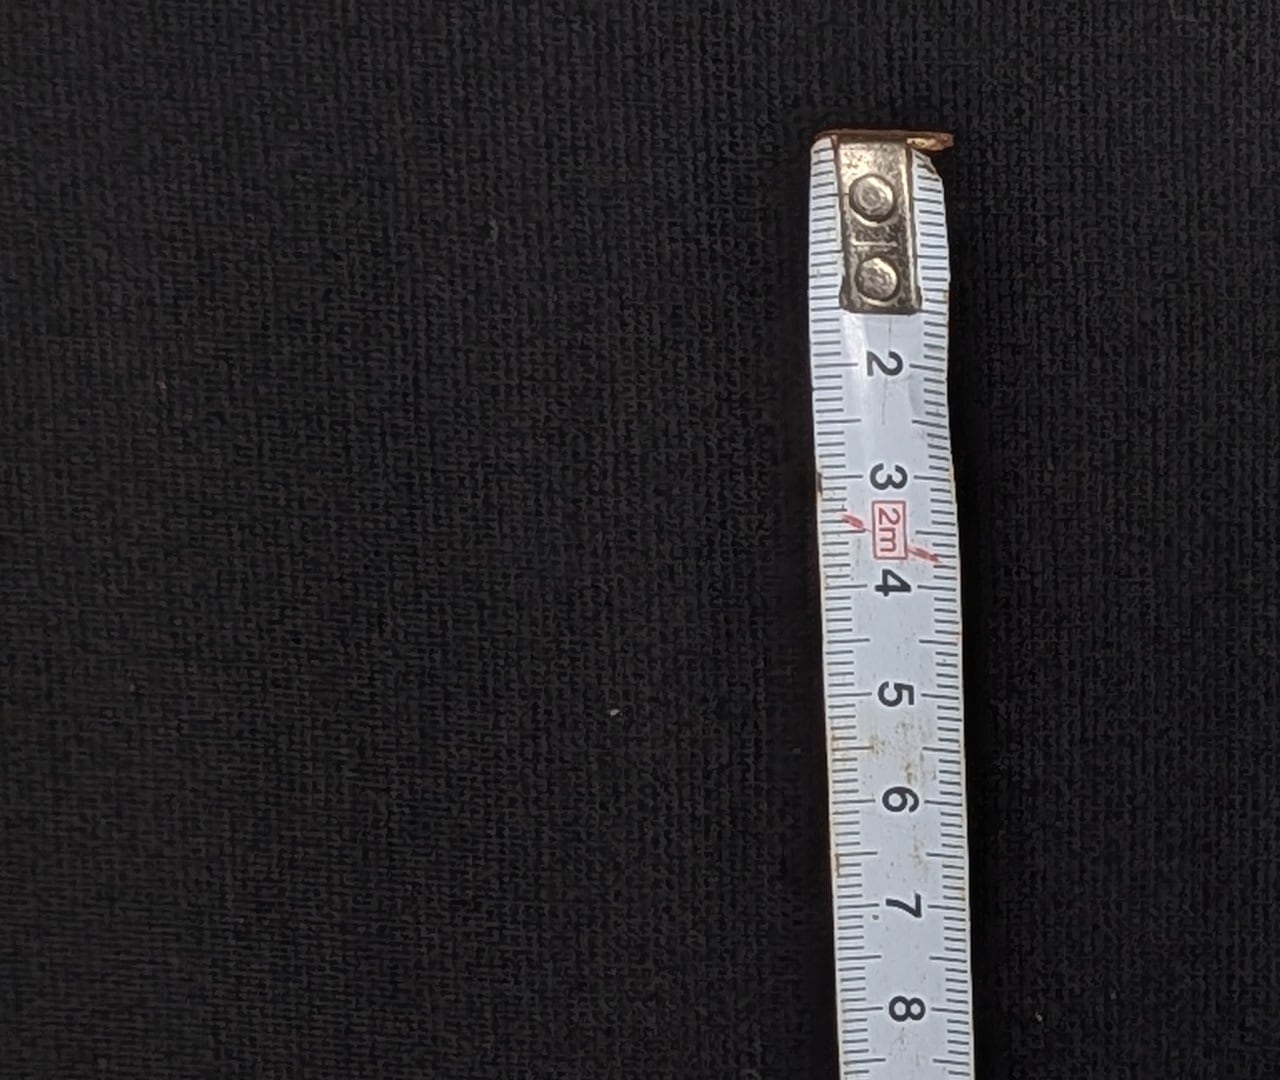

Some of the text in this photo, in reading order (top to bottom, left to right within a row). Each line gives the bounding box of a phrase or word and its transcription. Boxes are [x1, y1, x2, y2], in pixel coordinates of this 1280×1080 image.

[867, 351, 903, 376] 2
[870, 463, 908, 490] 3
[878, 508, 901, 552] 2m
[875, 569, 912, 597] 4
[877, 681, 915, 707] 5
[882, 786, 920, 813] 6
[885, 893, 922, 918] 7
[888, 995, 926, 1022] 8
